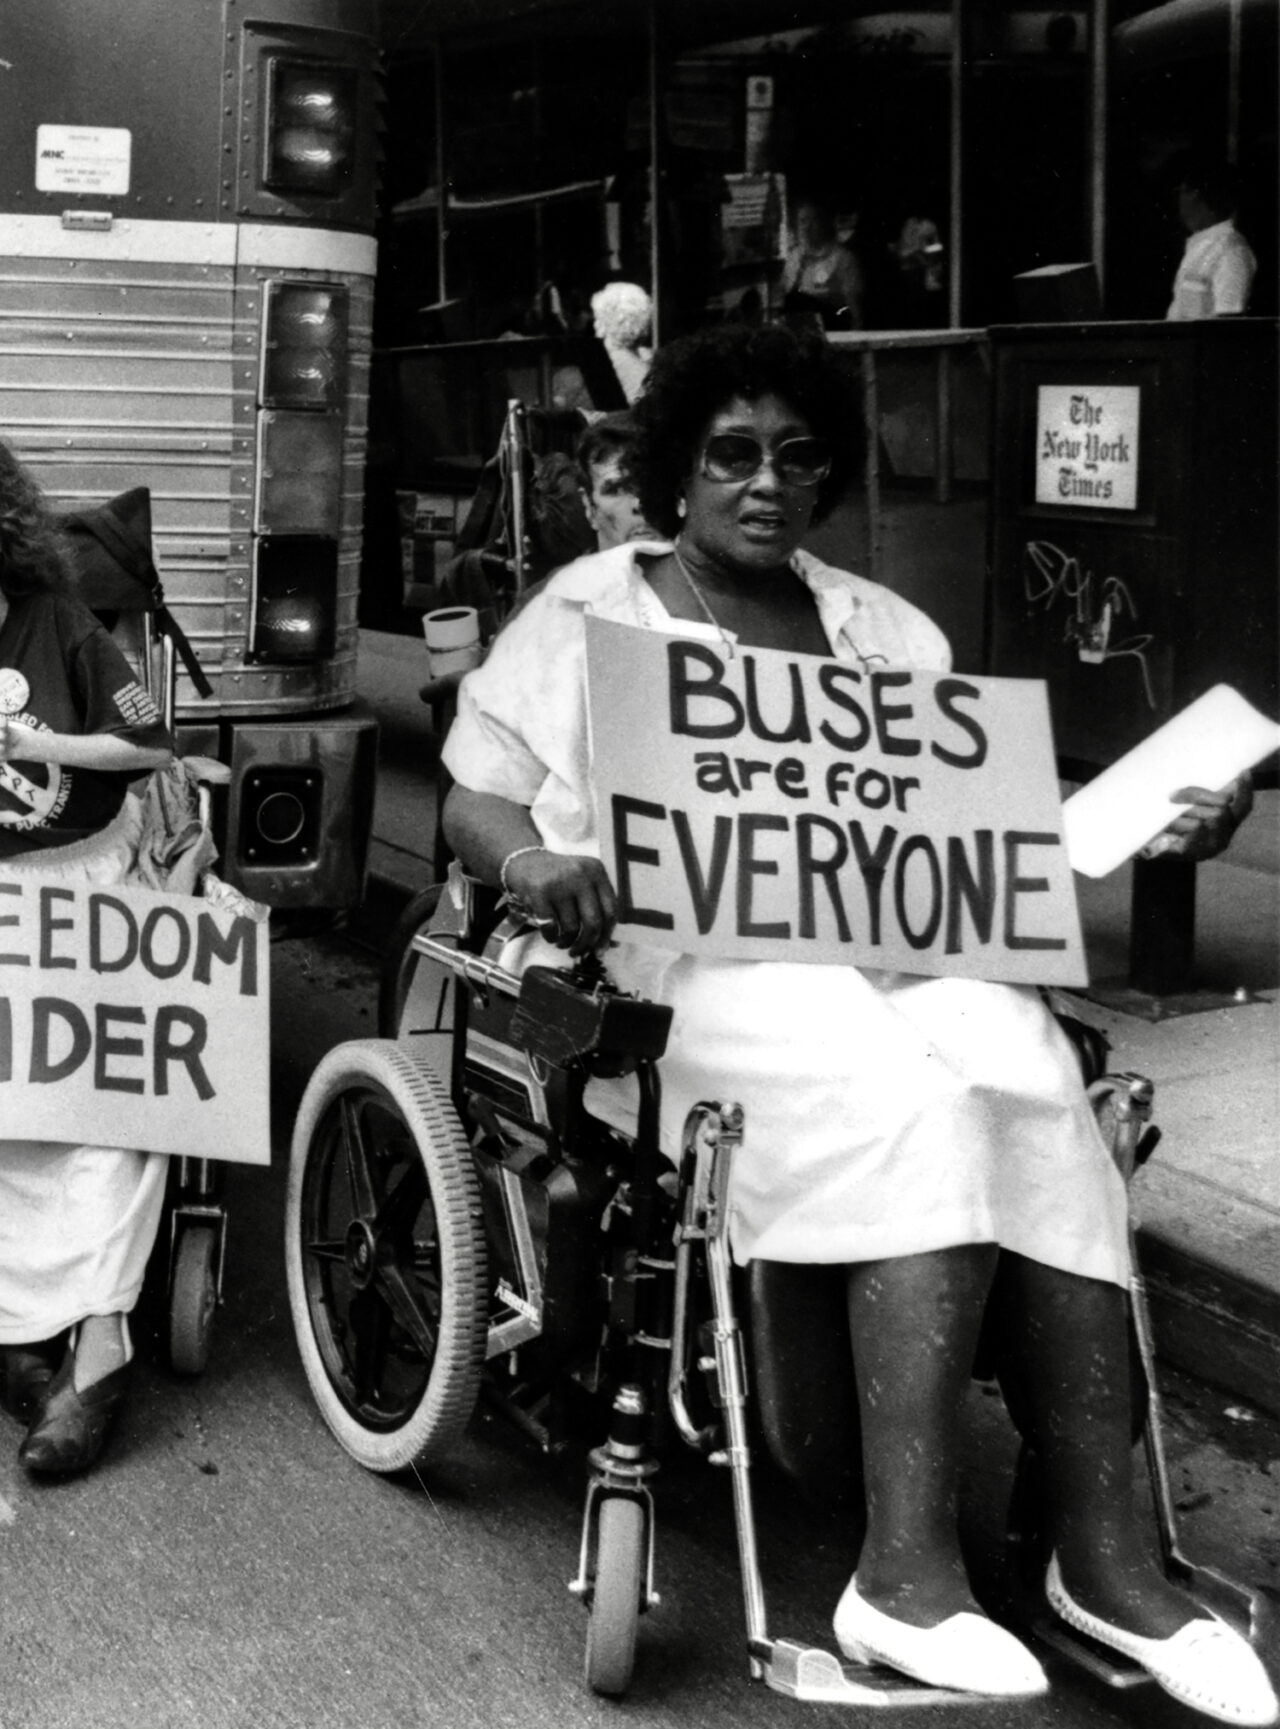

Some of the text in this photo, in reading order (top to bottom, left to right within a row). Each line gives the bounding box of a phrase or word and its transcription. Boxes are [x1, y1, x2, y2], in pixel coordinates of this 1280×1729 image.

[1070, 395, 1102, 427] The
[1042, 431, 1129, 473] New York
[1058, 467, 1113, 498] Times
[667, 641, 987, 768] BUSES
[694, 752, 920, 813] are for
[612, 793, 1067, 955] EVERYONE
